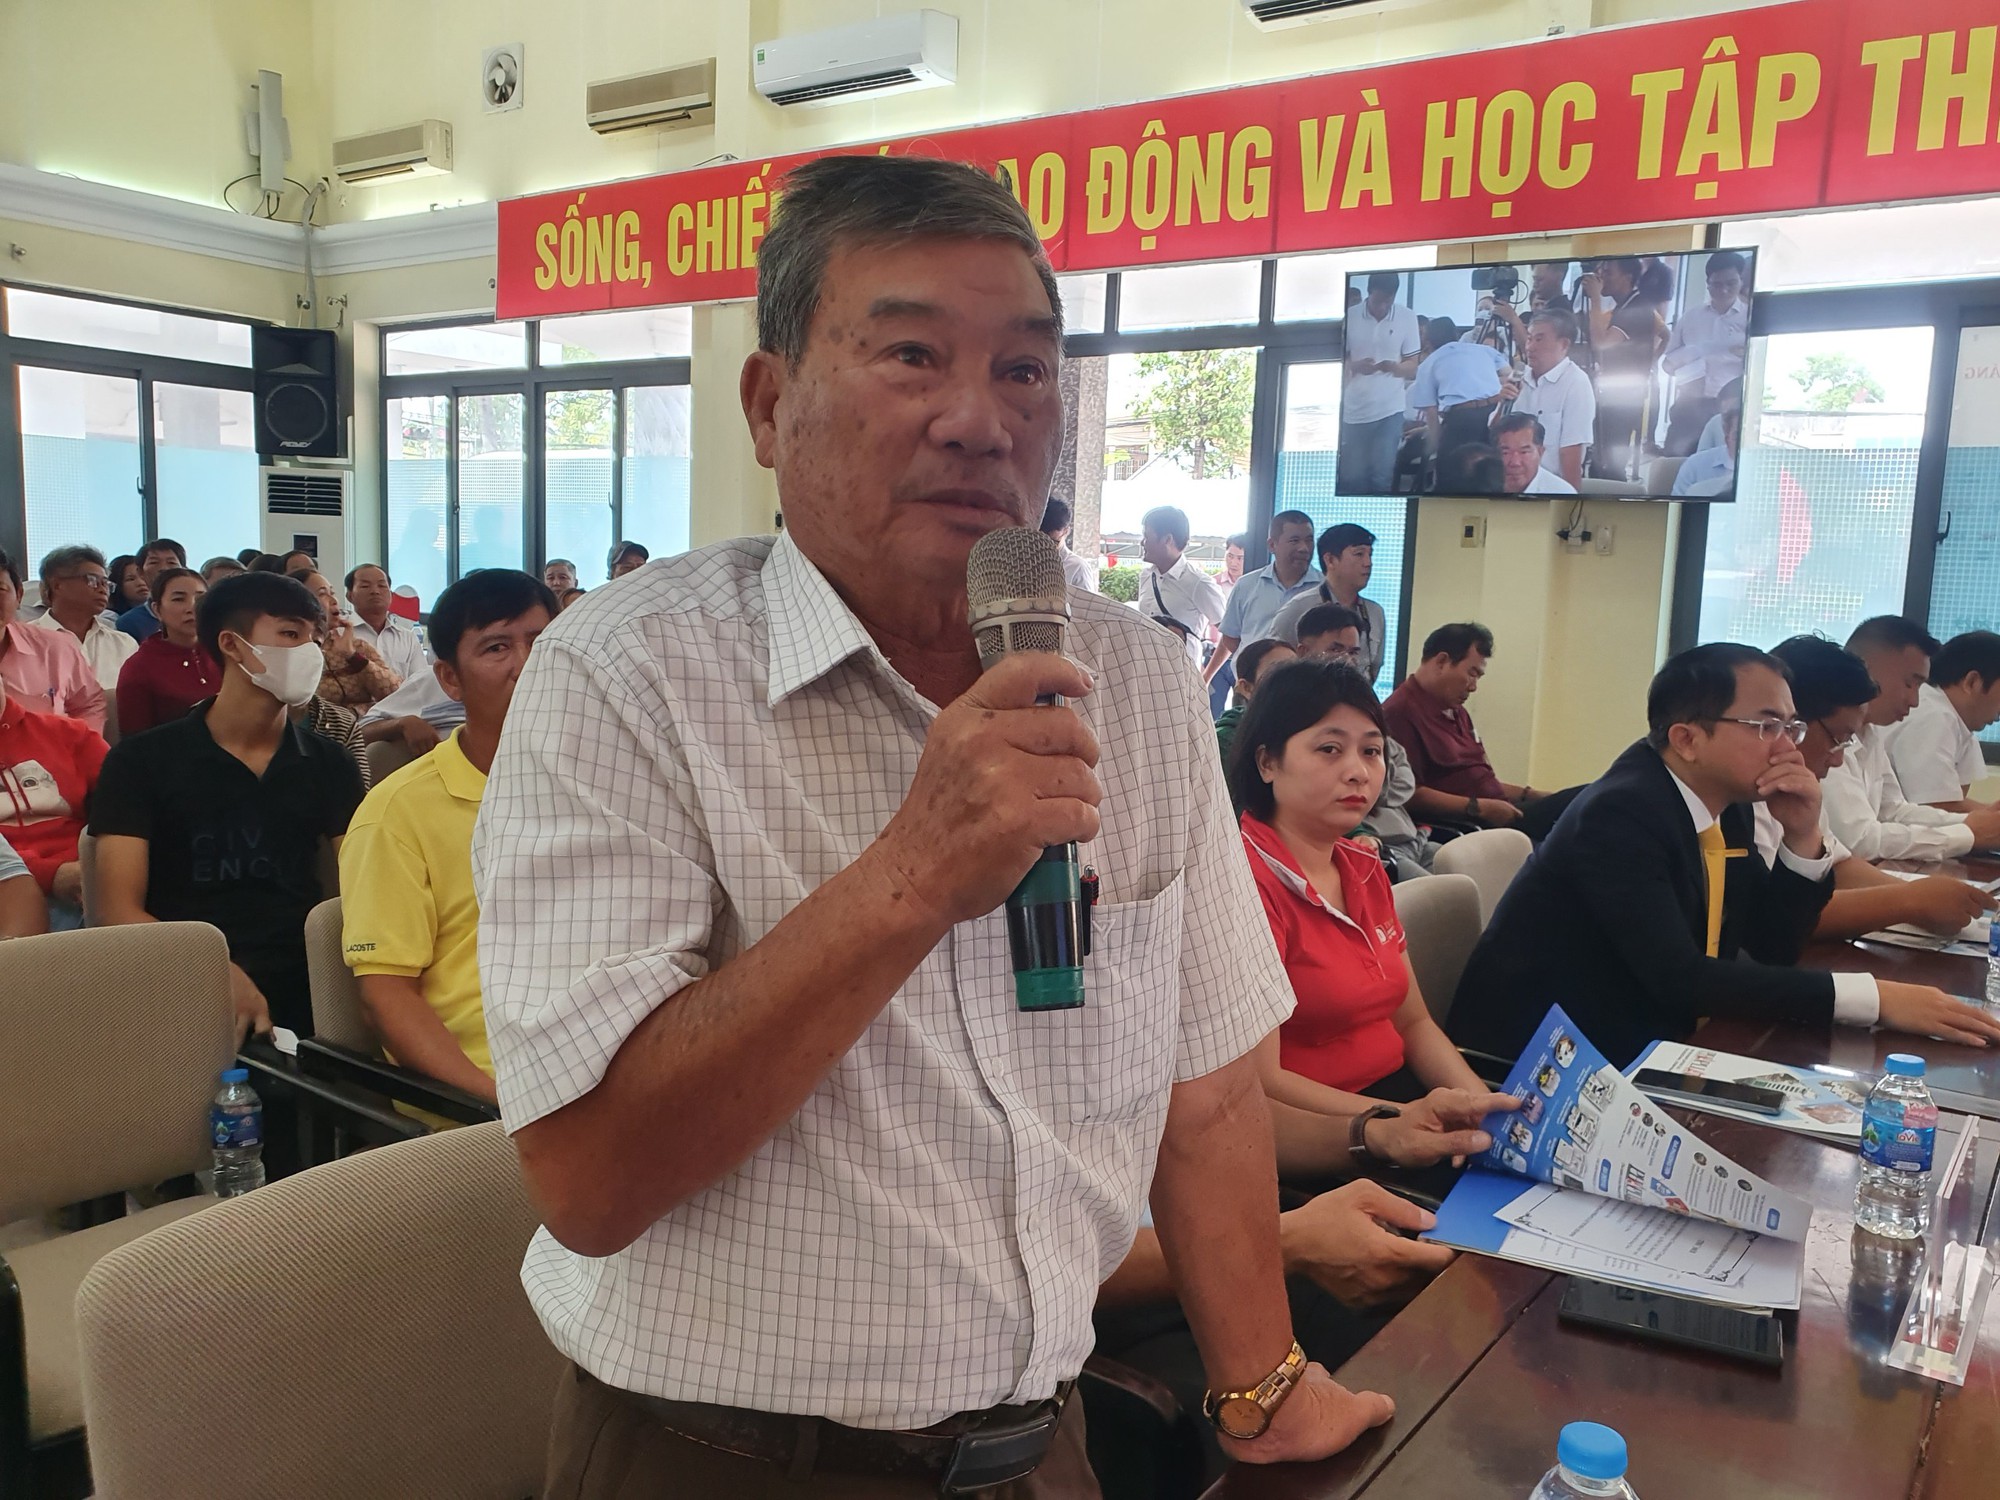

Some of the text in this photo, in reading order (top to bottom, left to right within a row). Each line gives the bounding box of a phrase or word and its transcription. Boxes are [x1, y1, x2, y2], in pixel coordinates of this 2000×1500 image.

[535, 193, 652, 290] SỐNG,
[1086, 119, 1273, 251] ĐỘNG
[1299, 88, 1393, 213] VÀ
[1421, 81, 1597, 218] HỌC
[1631, 35, 1822, 200] TẬP
[1861, 25, 2000, 156] TH
[346, 943, 376, 952] LACOSTE
